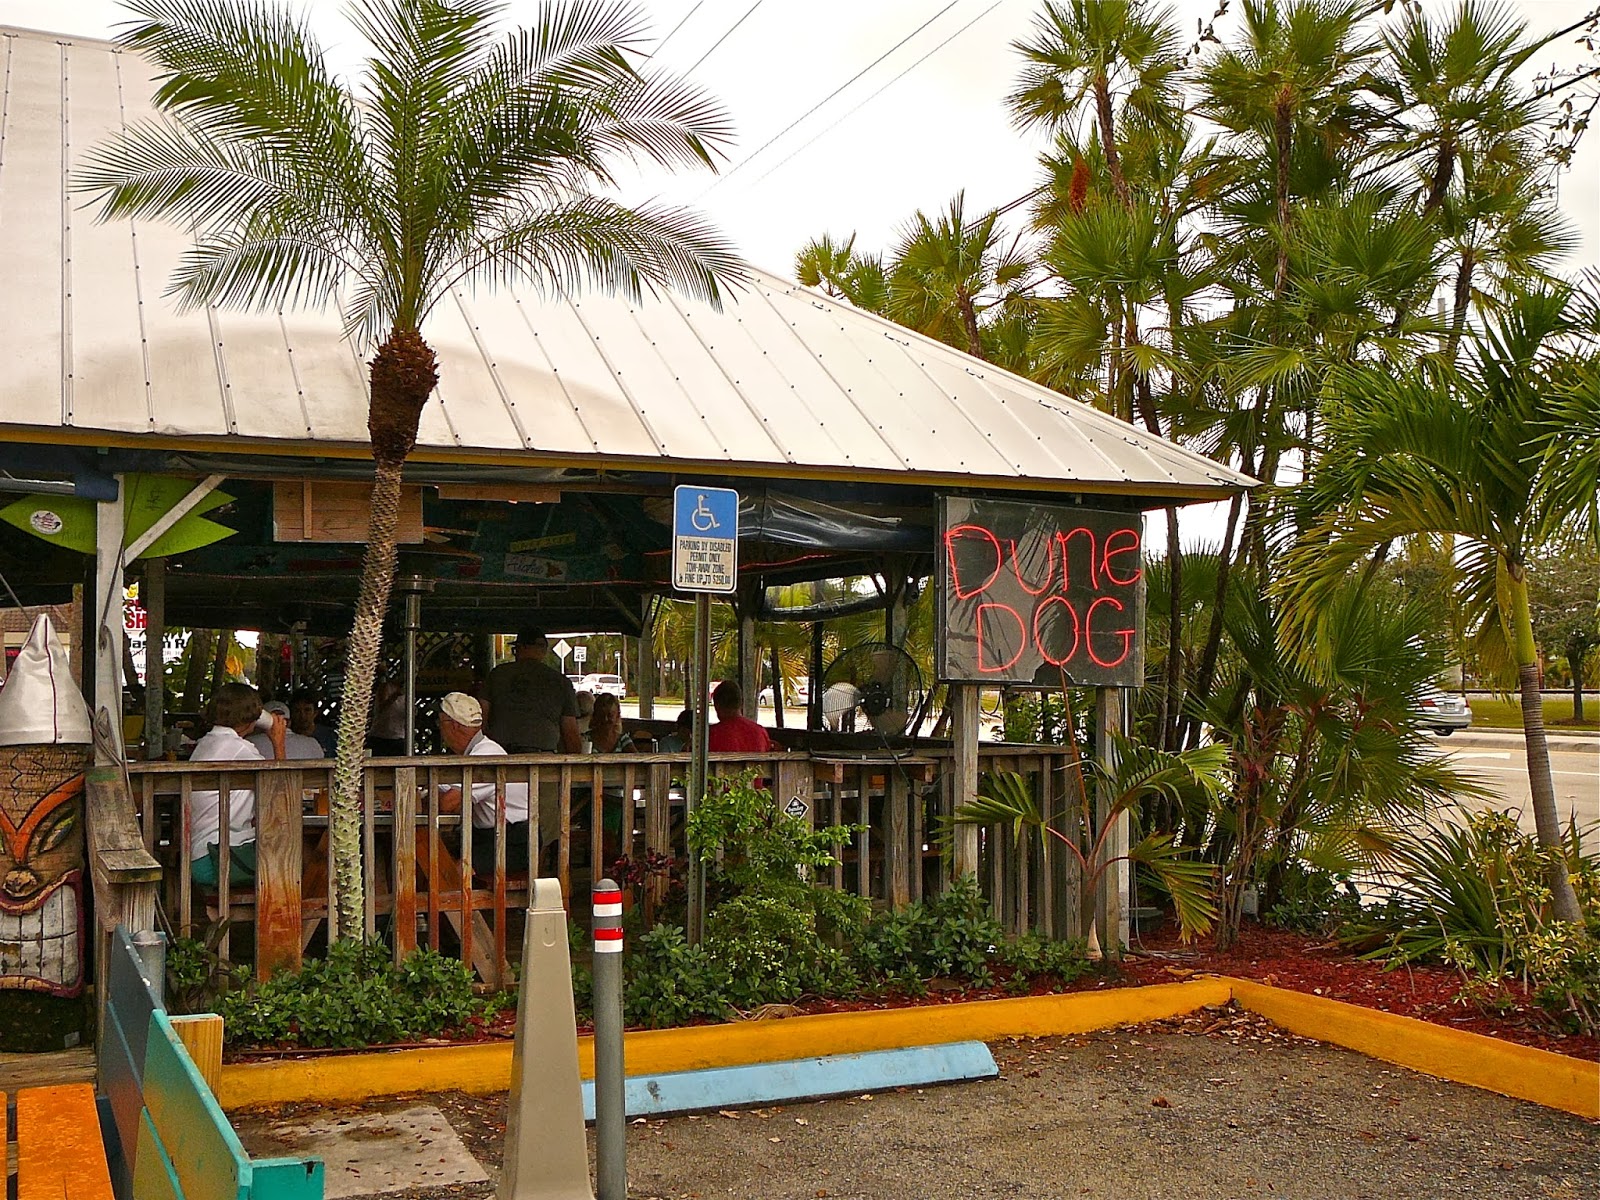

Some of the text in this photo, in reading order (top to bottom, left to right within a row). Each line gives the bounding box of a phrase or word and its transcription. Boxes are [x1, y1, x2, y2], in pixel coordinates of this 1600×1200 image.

[679, 540, 732, 552] PARKING BY DISABLED
[690, 552, 721, 563] PERMIT ONLY
[944, 524, 1142, 600] Dune
[686, 562, 725, 574] TOW-AWAY ZONE
[684, 574, 695, 583] FINE
[696, 574, 703, 584] UP
[705, 575, 711, 584] TO
[977, 596, 1135, 672] DOG
